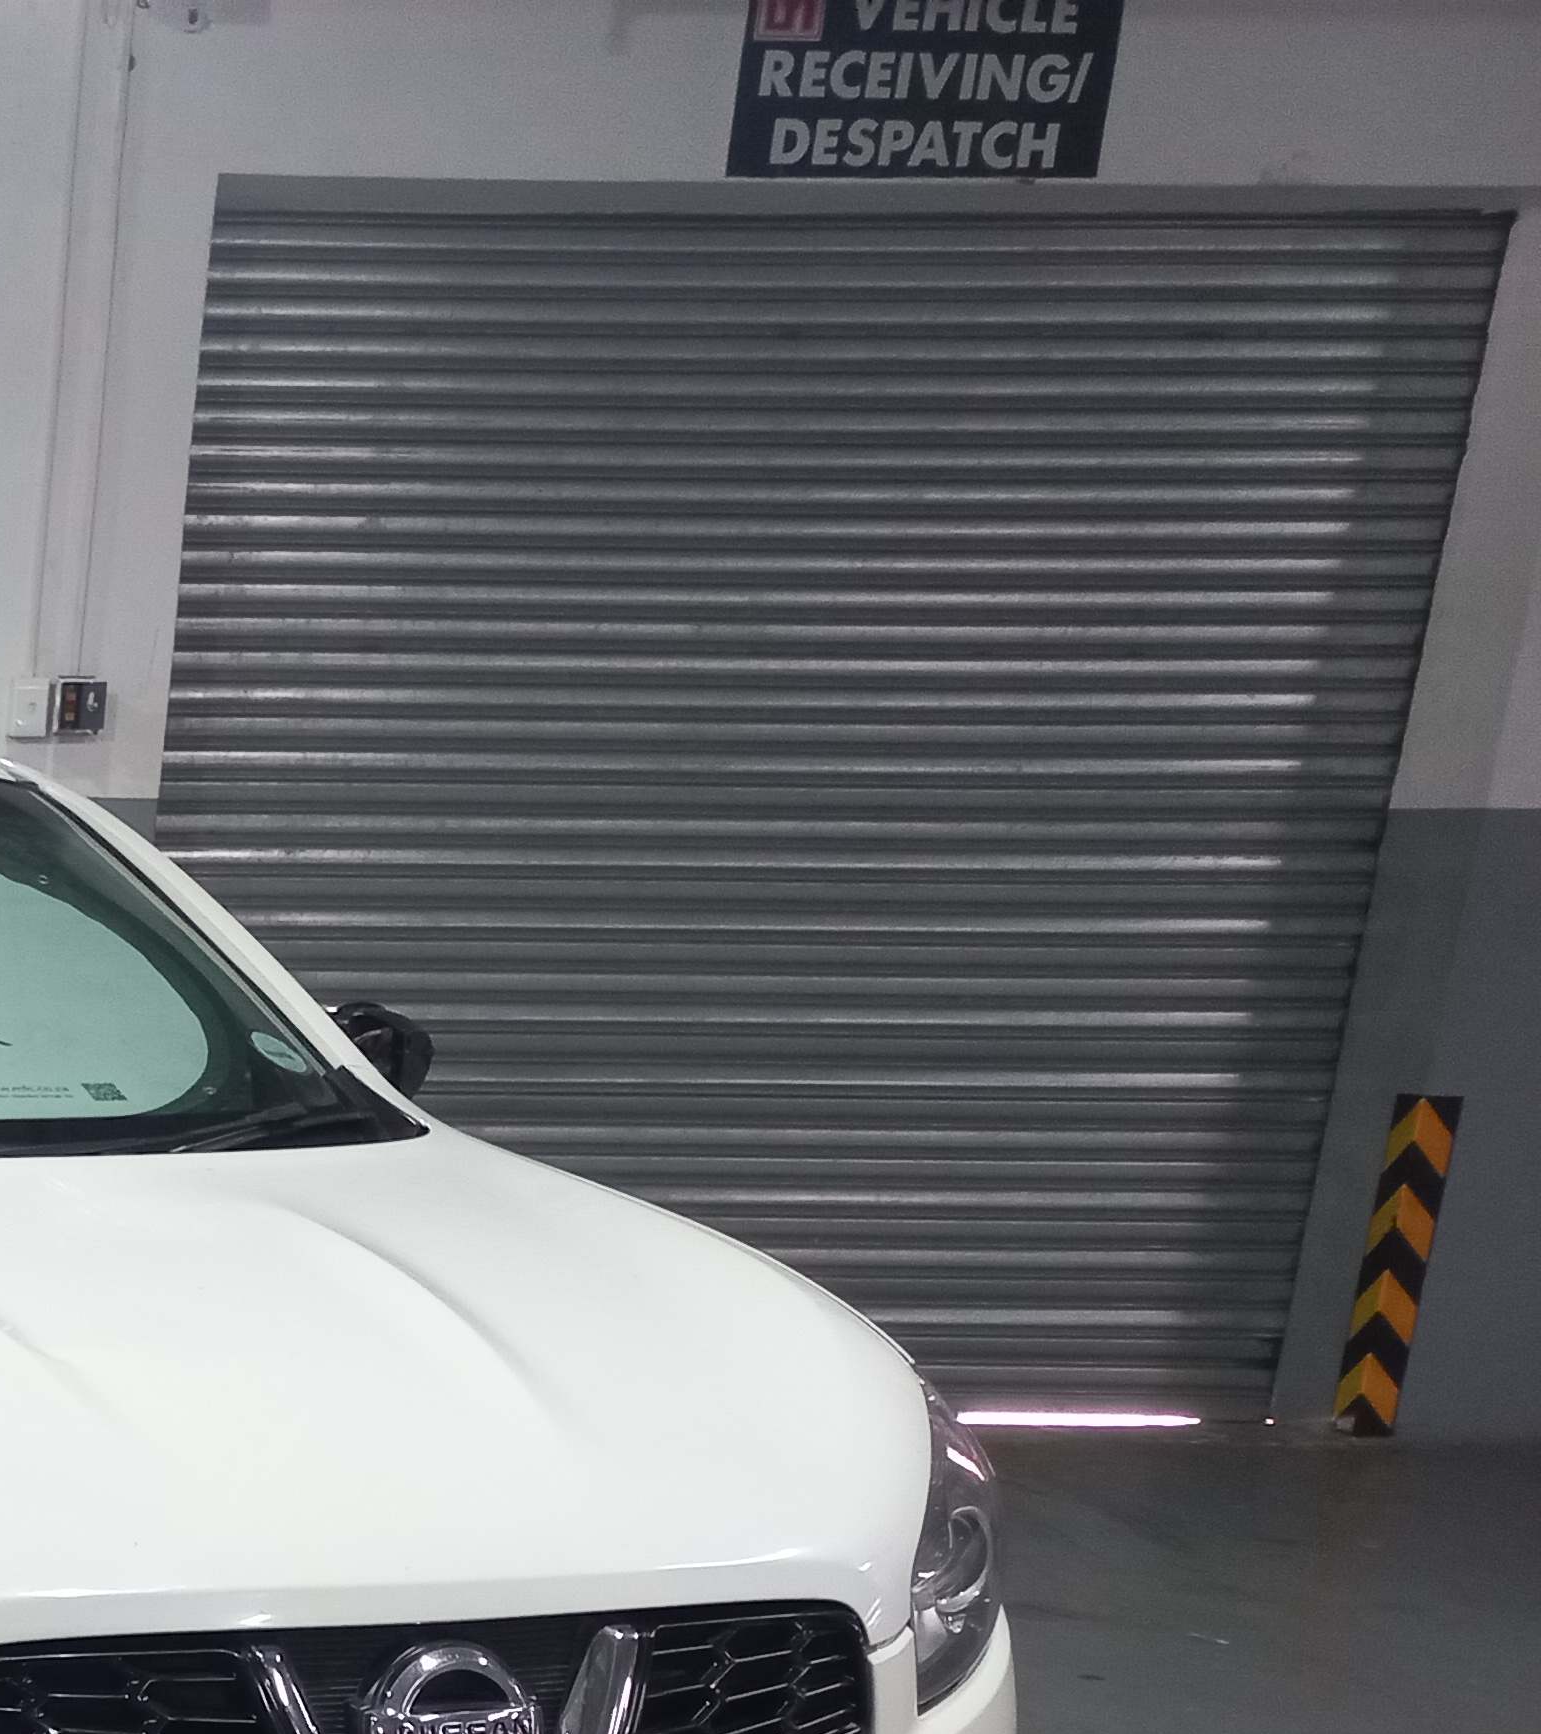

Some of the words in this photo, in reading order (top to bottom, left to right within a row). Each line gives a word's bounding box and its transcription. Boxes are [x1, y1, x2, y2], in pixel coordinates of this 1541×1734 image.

[856, 0, 1078, 34] VEHICLE
[758, 49, 1094, 104] RECEIVING/
[769, 117, 1062, 169] DESPATCH
